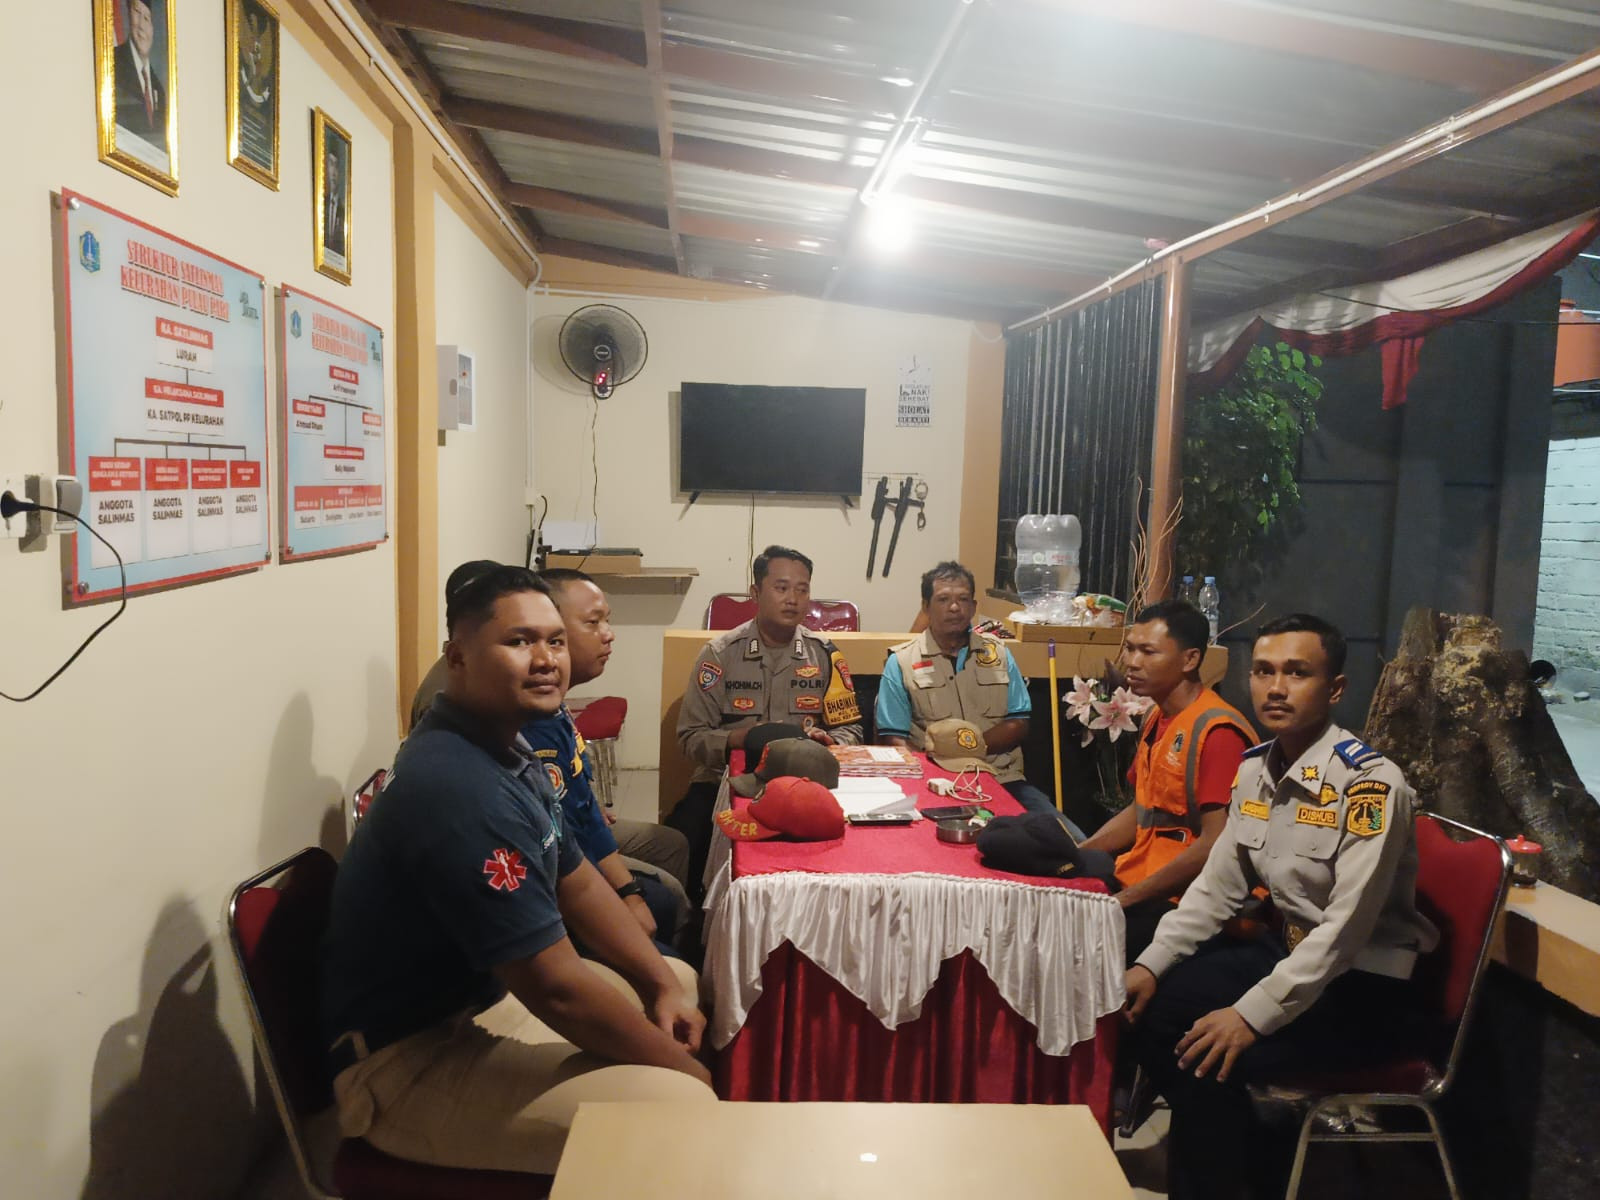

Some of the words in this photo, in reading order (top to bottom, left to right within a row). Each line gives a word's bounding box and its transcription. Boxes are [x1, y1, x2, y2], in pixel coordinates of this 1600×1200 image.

[175, 348, 197, 362] LURAH
[191, 413, 225, 426] KELURAHAN
[99, 500, 134, 510] ANGGOTA
[790, 679, 825, 689] POLRI
[1300, 809, 1335, 823] DISHUB
